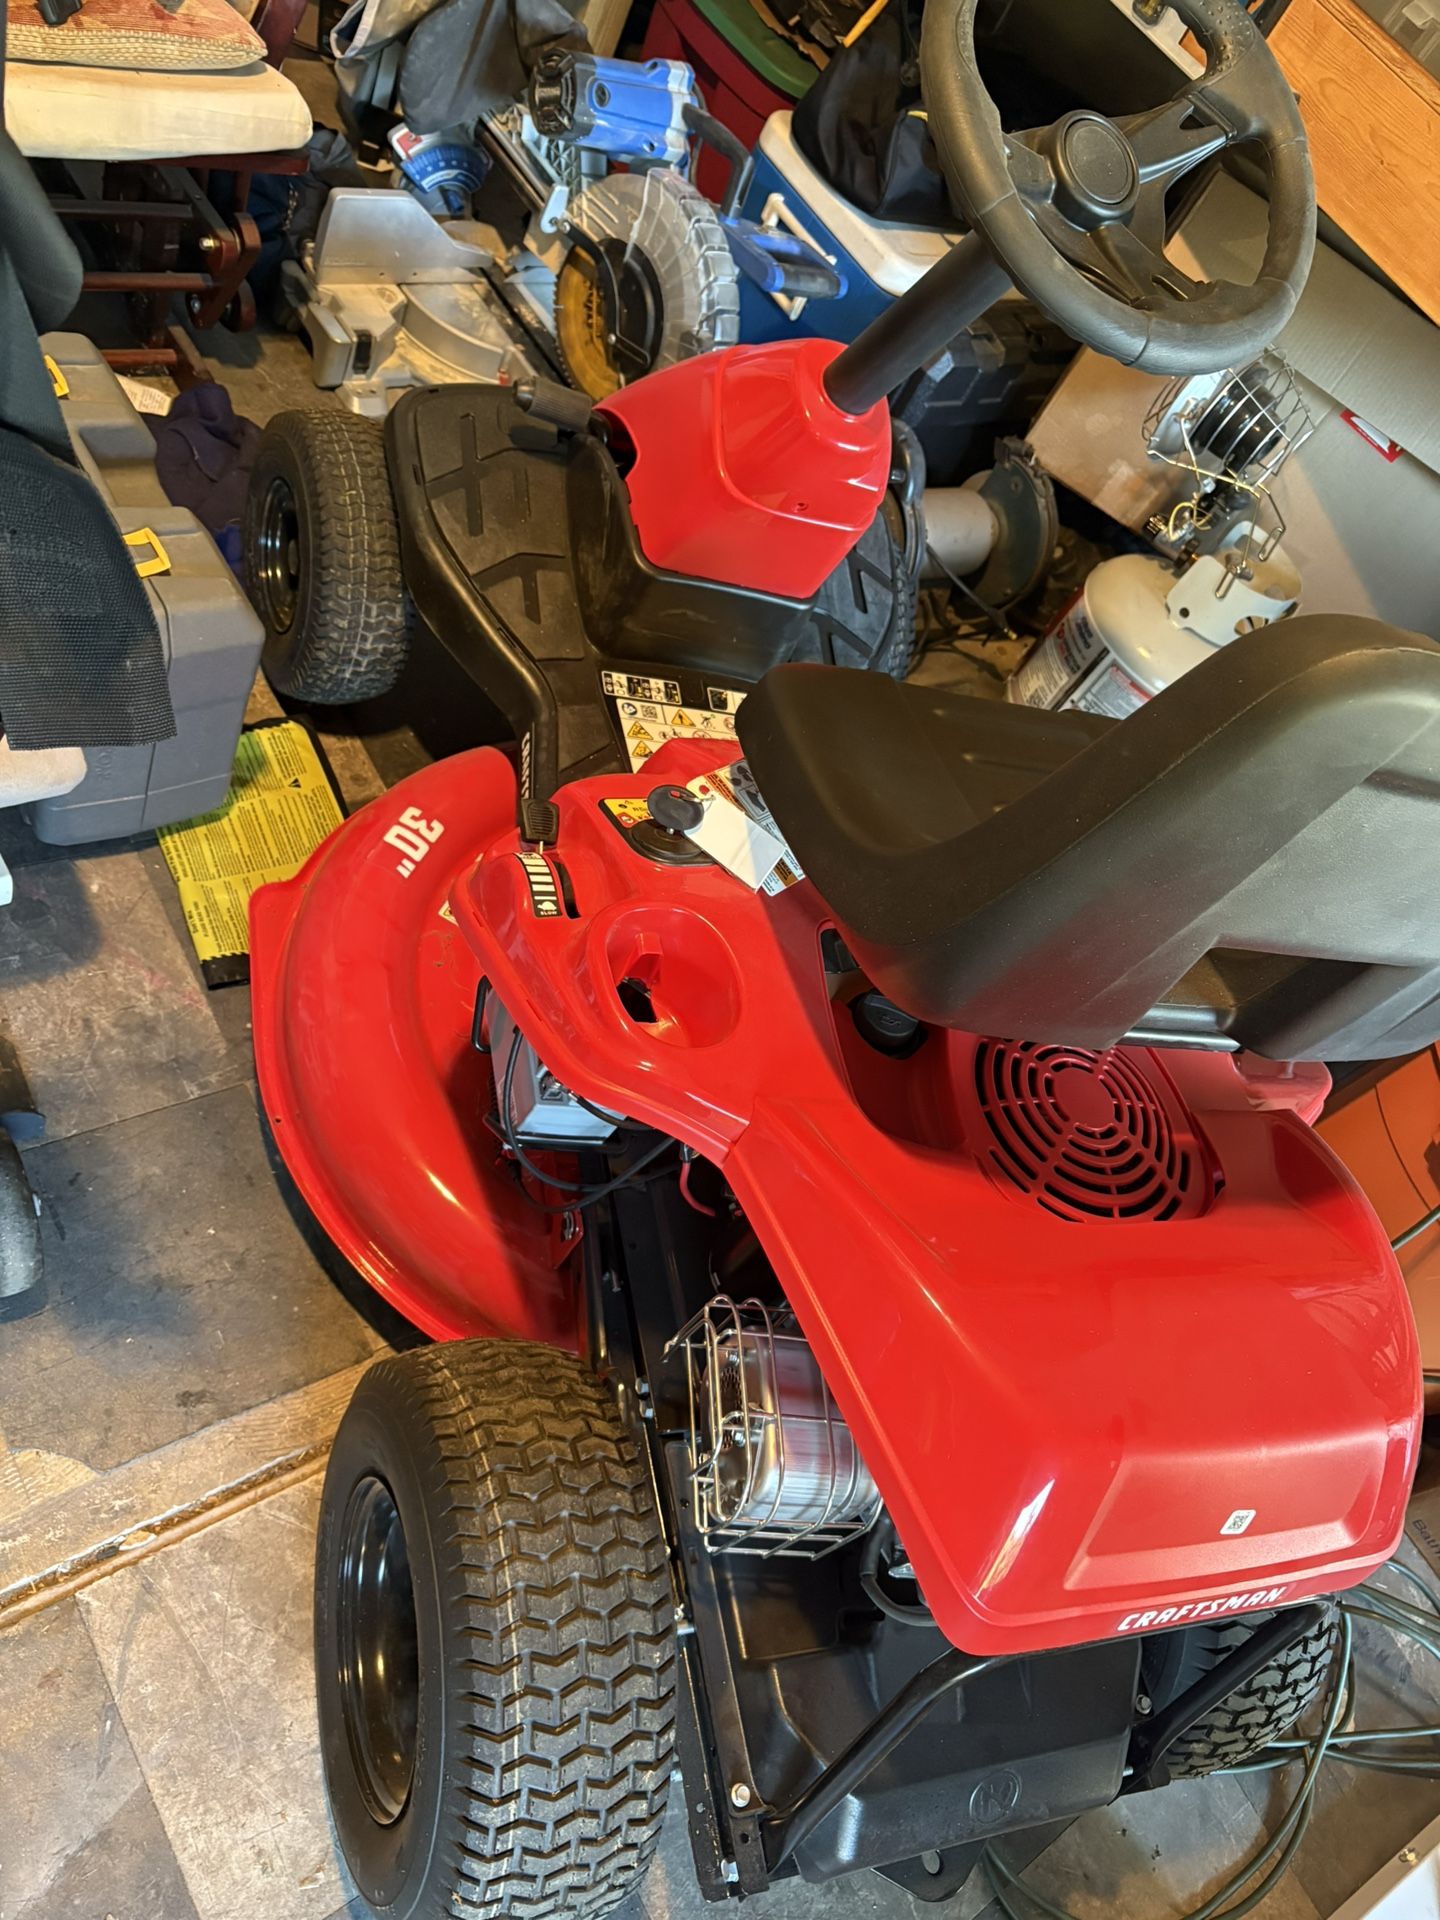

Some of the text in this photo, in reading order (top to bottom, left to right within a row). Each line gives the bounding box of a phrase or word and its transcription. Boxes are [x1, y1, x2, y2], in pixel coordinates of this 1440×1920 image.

[521, 731, 530, 799] CRAFT
[383, 806, 445, 878] 30"
[1117, 1586, 1287, 1632] CRAFTSMAN
